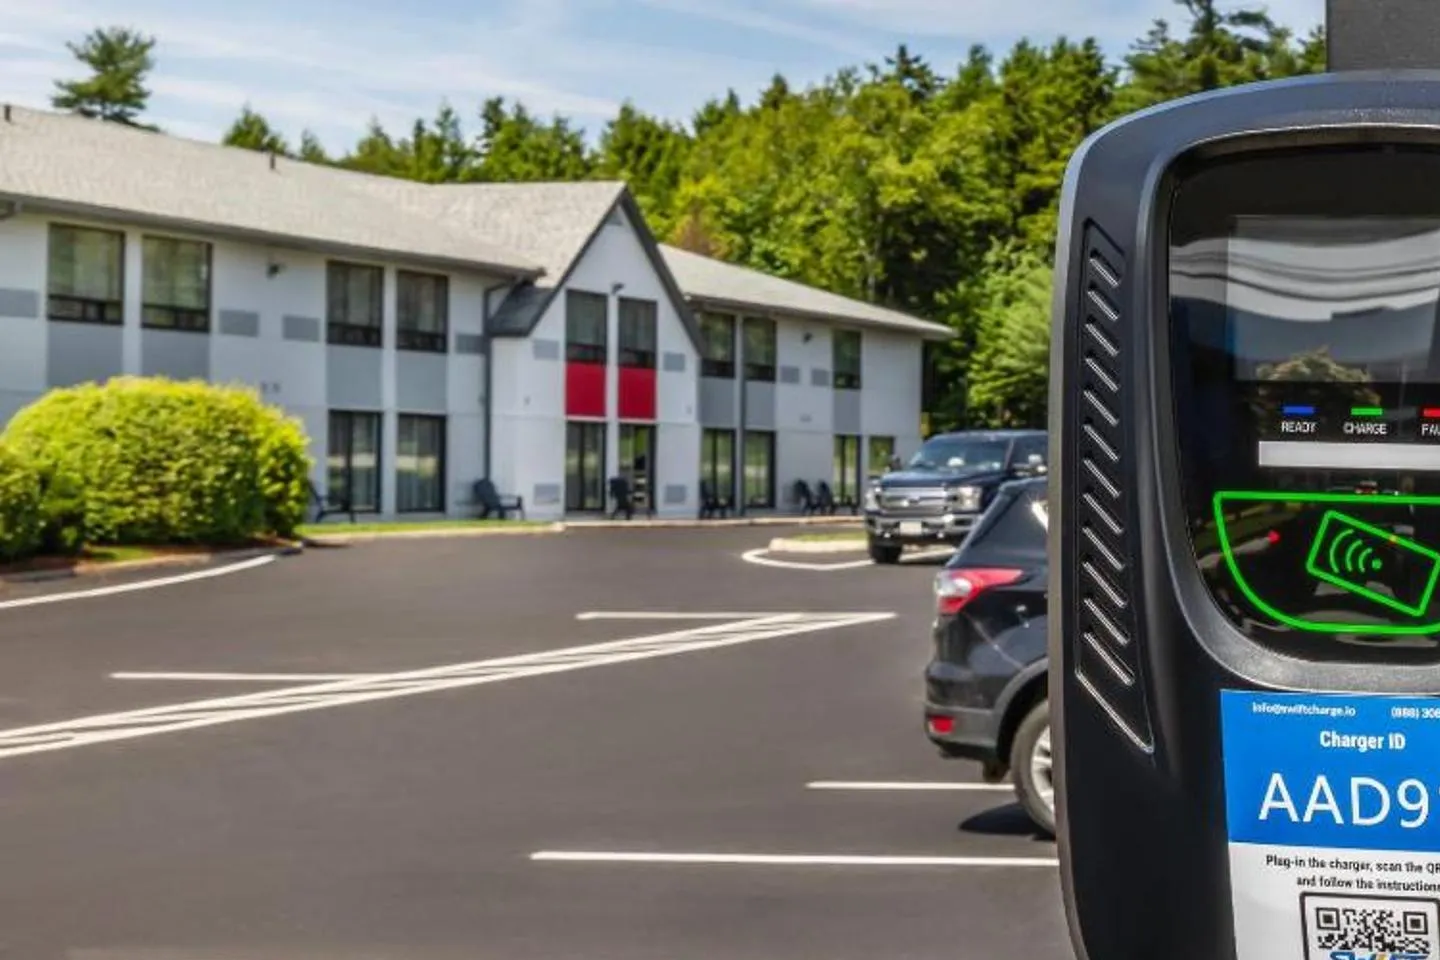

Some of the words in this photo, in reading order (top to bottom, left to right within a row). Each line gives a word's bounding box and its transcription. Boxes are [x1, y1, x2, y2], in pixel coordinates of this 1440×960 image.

[1281, 421, 1317, 433] READY
[1343, 422, 1388, 435] CHARGE
[1320, 730, 1384, 752] Charger
[1388, 732, 1406, 749] ID
[1266, 854, 1306, 869] Plug-in
[1308, 857, 1326, 868] the
[1329, 859, 1373, 872] charger,
[1376, 863, 1402, 872] scan
[1405, 862, 1423, 873] the
[1297, 875, 1316, 886] and
[1319, 876, 1352, 888] follow
[1356, 878, 1374, 889] the
